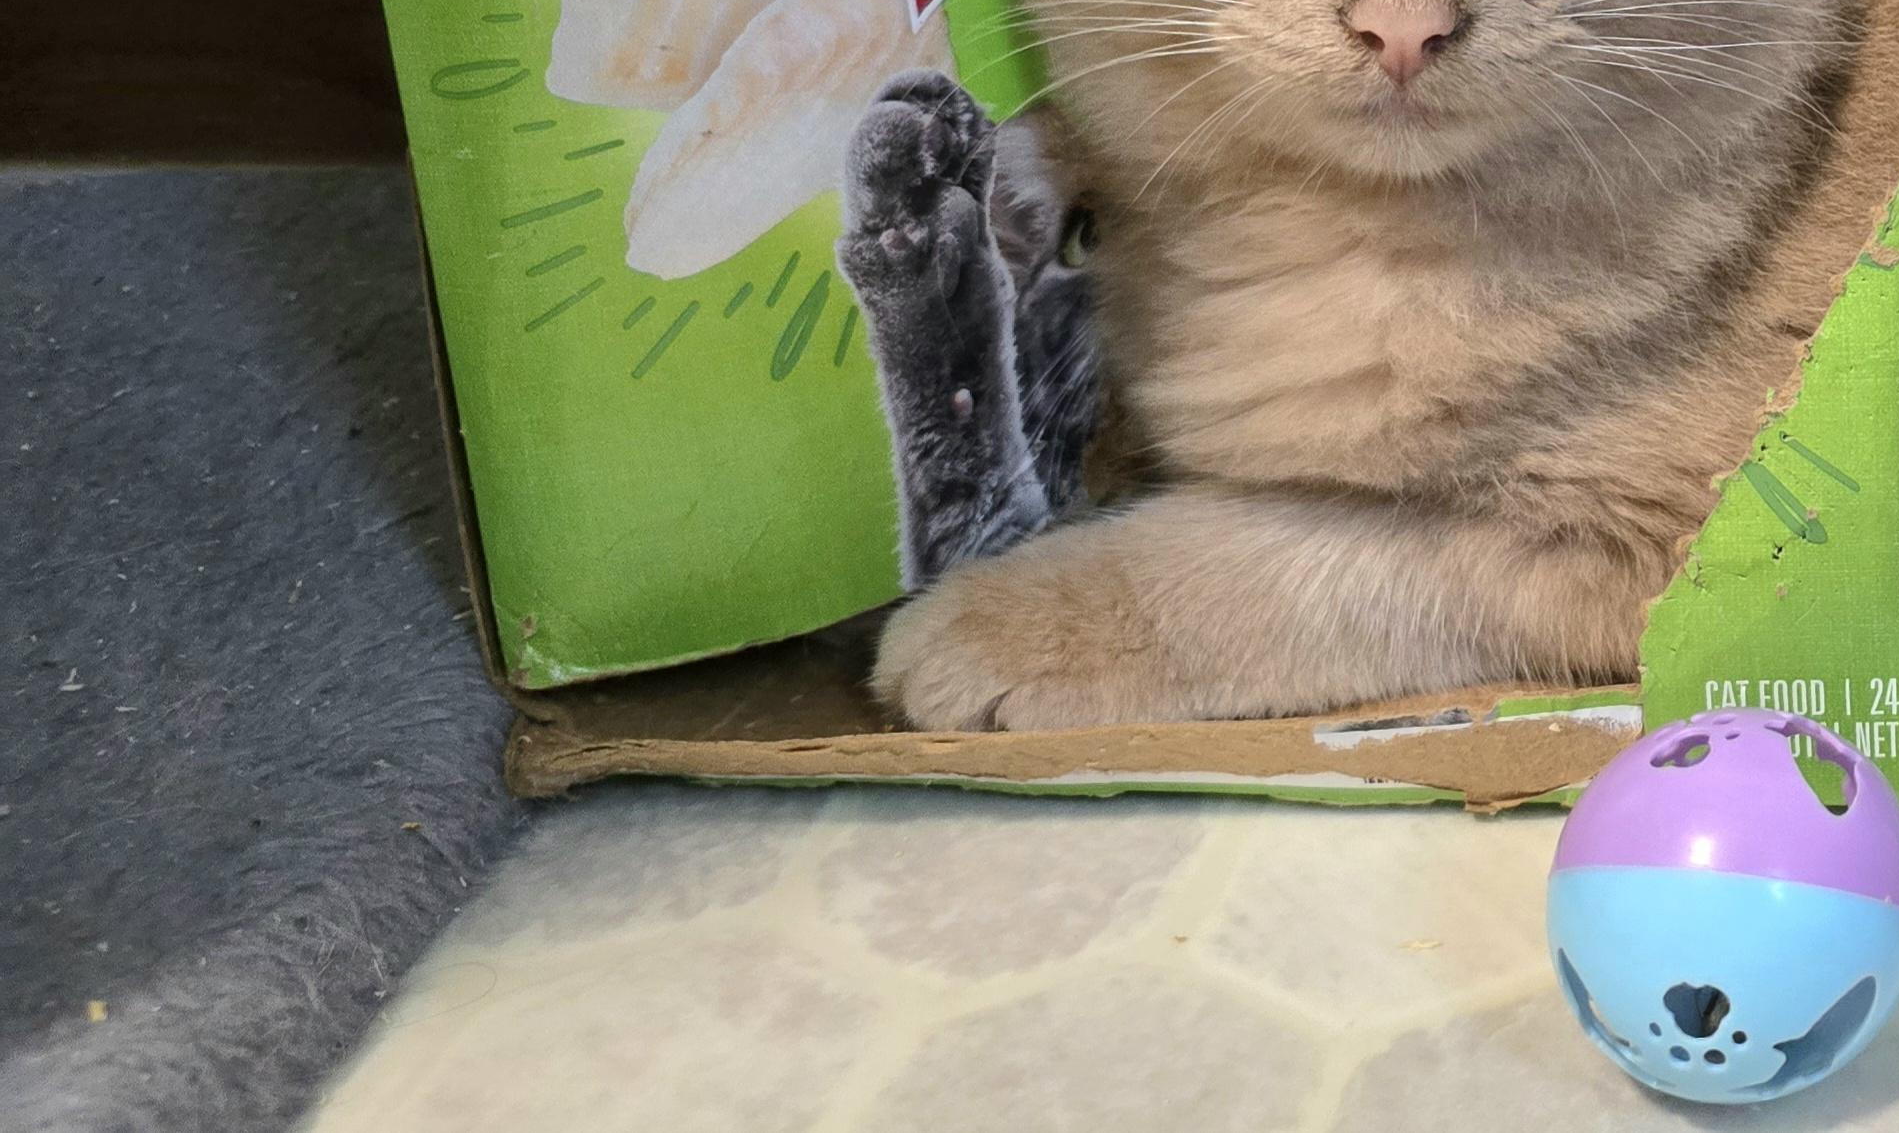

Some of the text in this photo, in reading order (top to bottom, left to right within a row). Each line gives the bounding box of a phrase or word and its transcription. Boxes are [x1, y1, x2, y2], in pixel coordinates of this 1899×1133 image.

[1705, 679, 1748, 712] CAT
[1759, 679, 1826, 716] FOOD
[1856, 720, 1899, 759] NET
